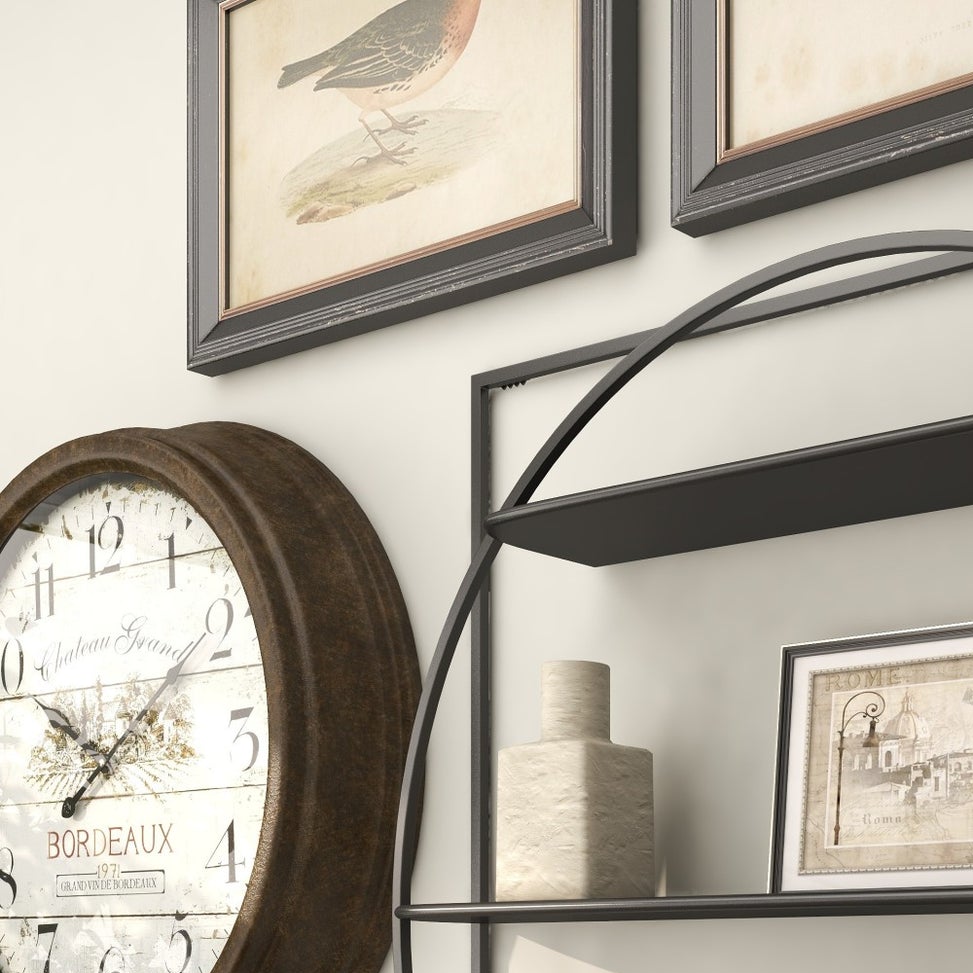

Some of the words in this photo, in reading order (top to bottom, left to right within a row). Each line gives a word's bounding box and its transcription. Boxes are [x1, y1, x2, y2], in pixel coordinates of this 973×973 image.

[85, 515, 124, 579] 12
[159, 532, 176, 590] 1
[32, 563, 54, 621] 11
[34, 634, 111, 682] Chateau
[205, 598, 234, 662] 2
[825, 667, 901, 692] ROME
[228, 706, 260, 772] 3
[47, 823, 174, 859] BORDEAUX
[204, 819, 246, 884] 4
[61, 881, 88, 892] GRAND
[87, 880, 101, 890] VIN
[101, 879, 112, 890] DE
[113, 877, 157, 889] BORDEAUX
[97, 863, 121, 878] 1971
